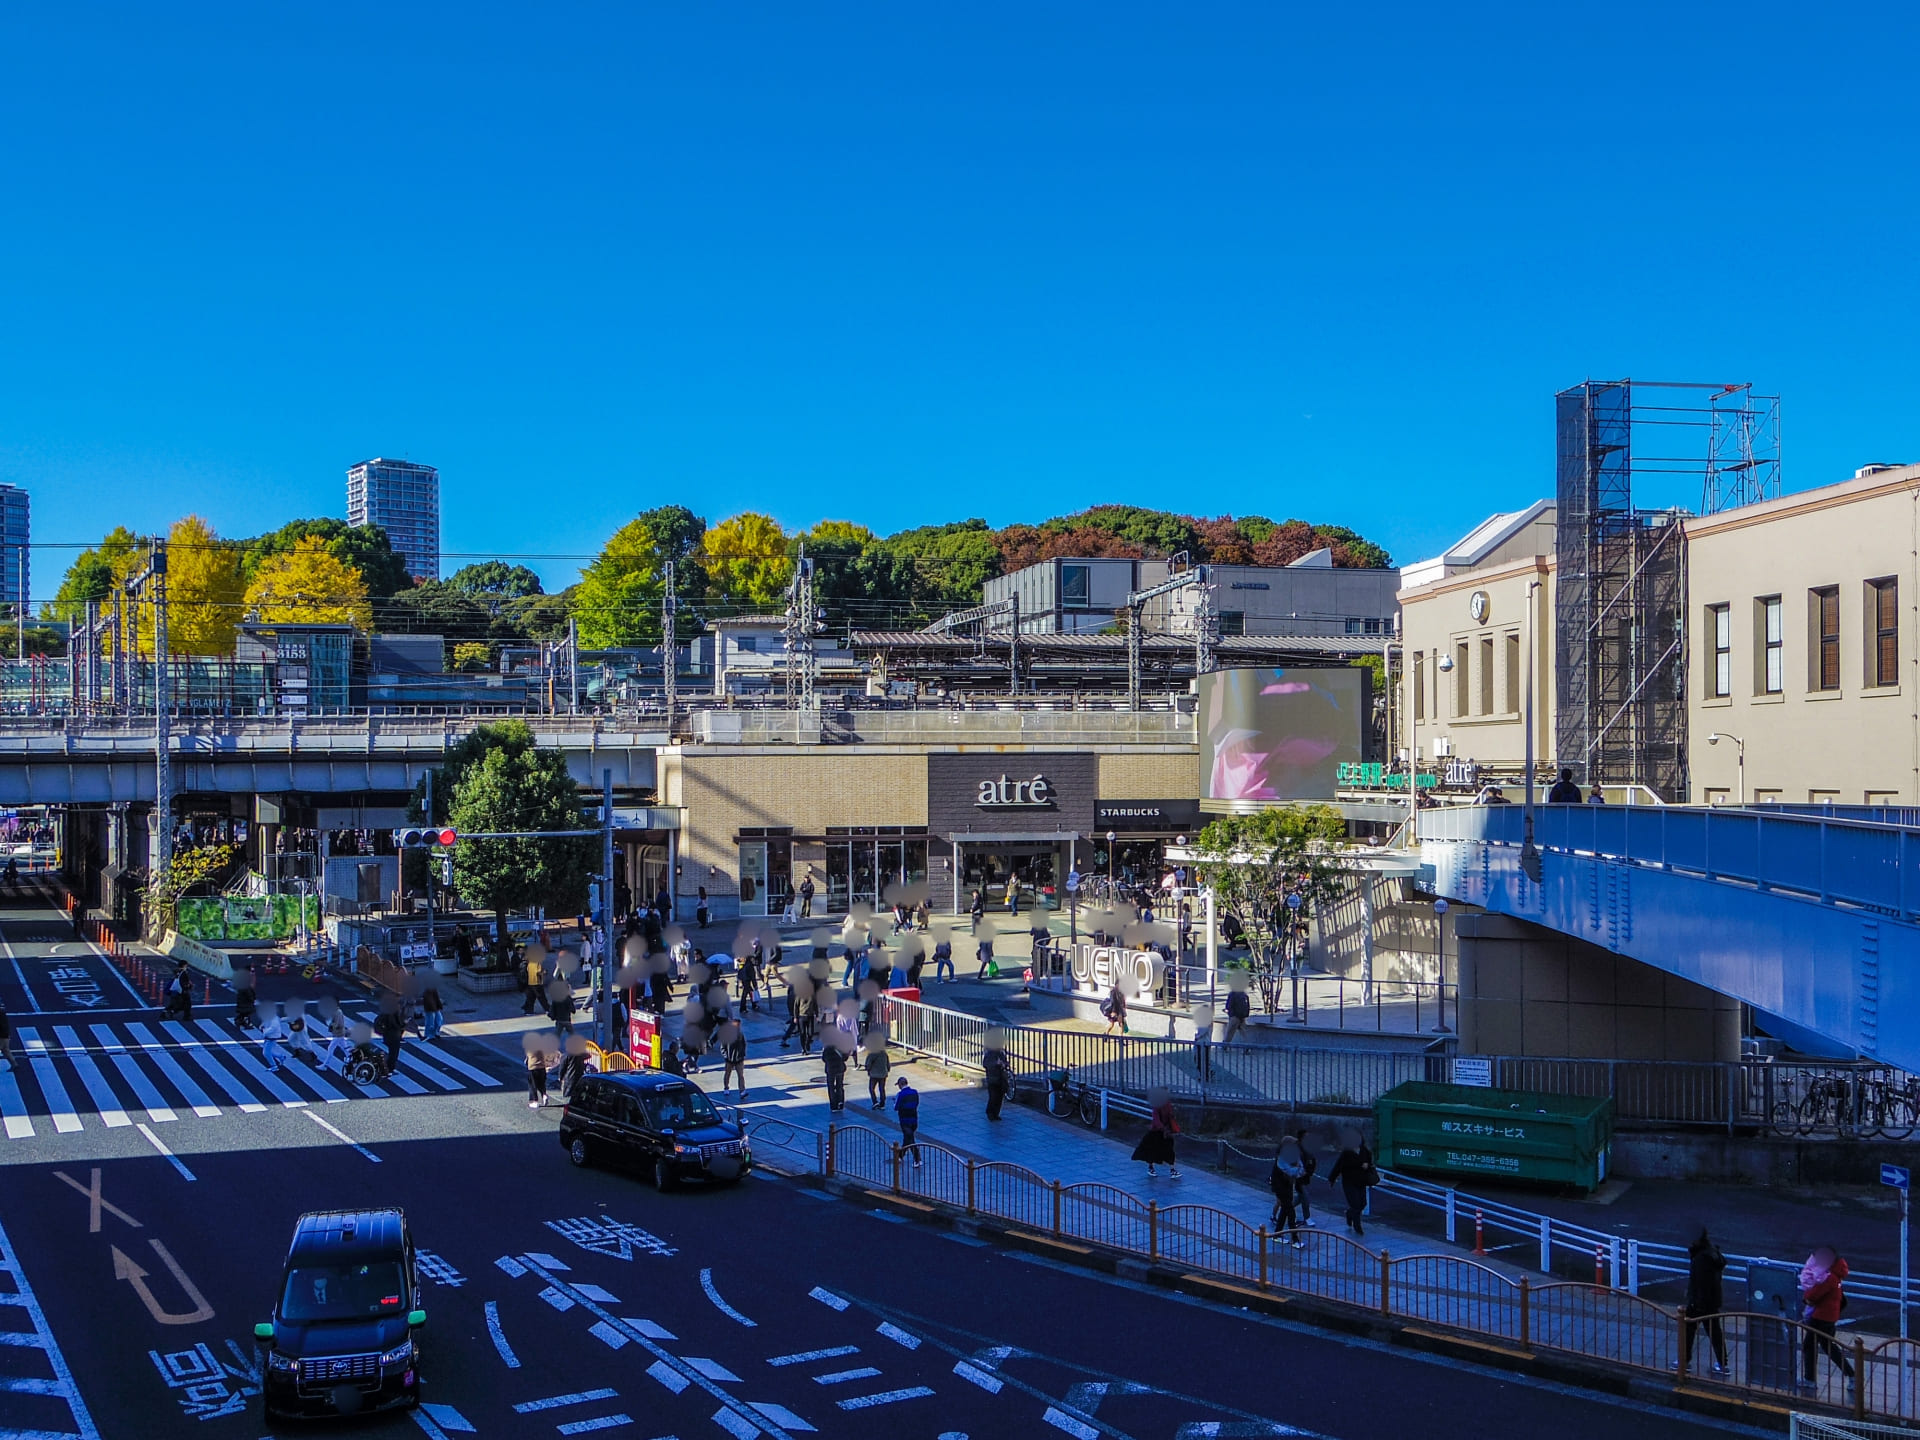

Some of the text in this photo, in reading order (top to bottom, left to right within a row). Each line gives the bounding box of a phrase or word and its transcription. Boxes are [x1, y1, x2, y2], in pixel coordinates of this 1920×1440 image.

[1445, 757, 1472, 784] atré
[978, 774, 1049, 804] atré
[1100, 808, 1160, 817] STARBUCKS
[1071, 944, 1154, 992] UENO
